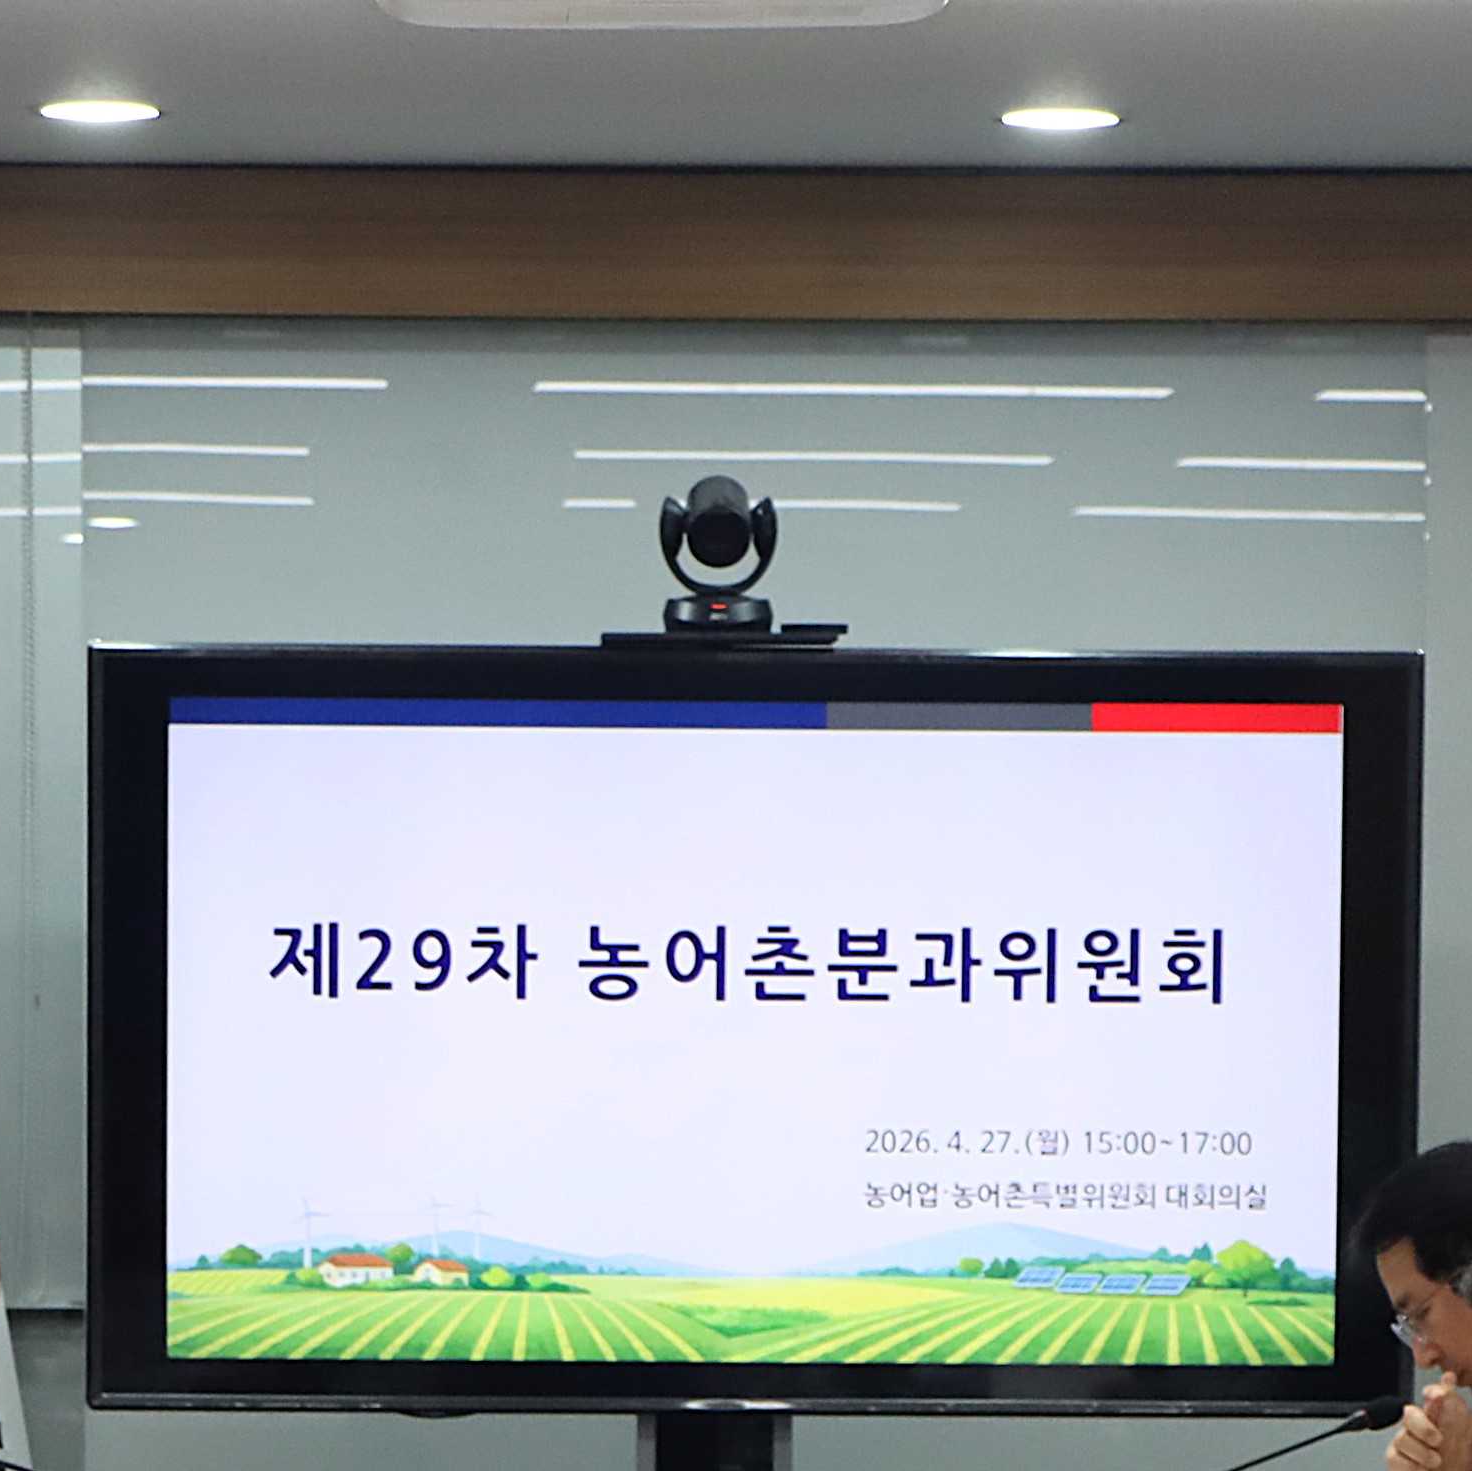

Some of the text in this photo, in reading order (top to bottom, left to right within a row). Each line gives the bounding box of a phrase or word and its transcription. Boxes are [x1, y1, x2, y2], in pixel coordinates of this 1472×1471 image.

[268, 922, 1222, 1005] 제29차 농어촌분과위원회
[864, 1129, 938, 1156] 2026.
[945, 1129, 970, 1156] 4.
[1084, 1129, 1253, 1156] 15:00~17:00
[1164, 1181, 1268, 1211] 대회의실
